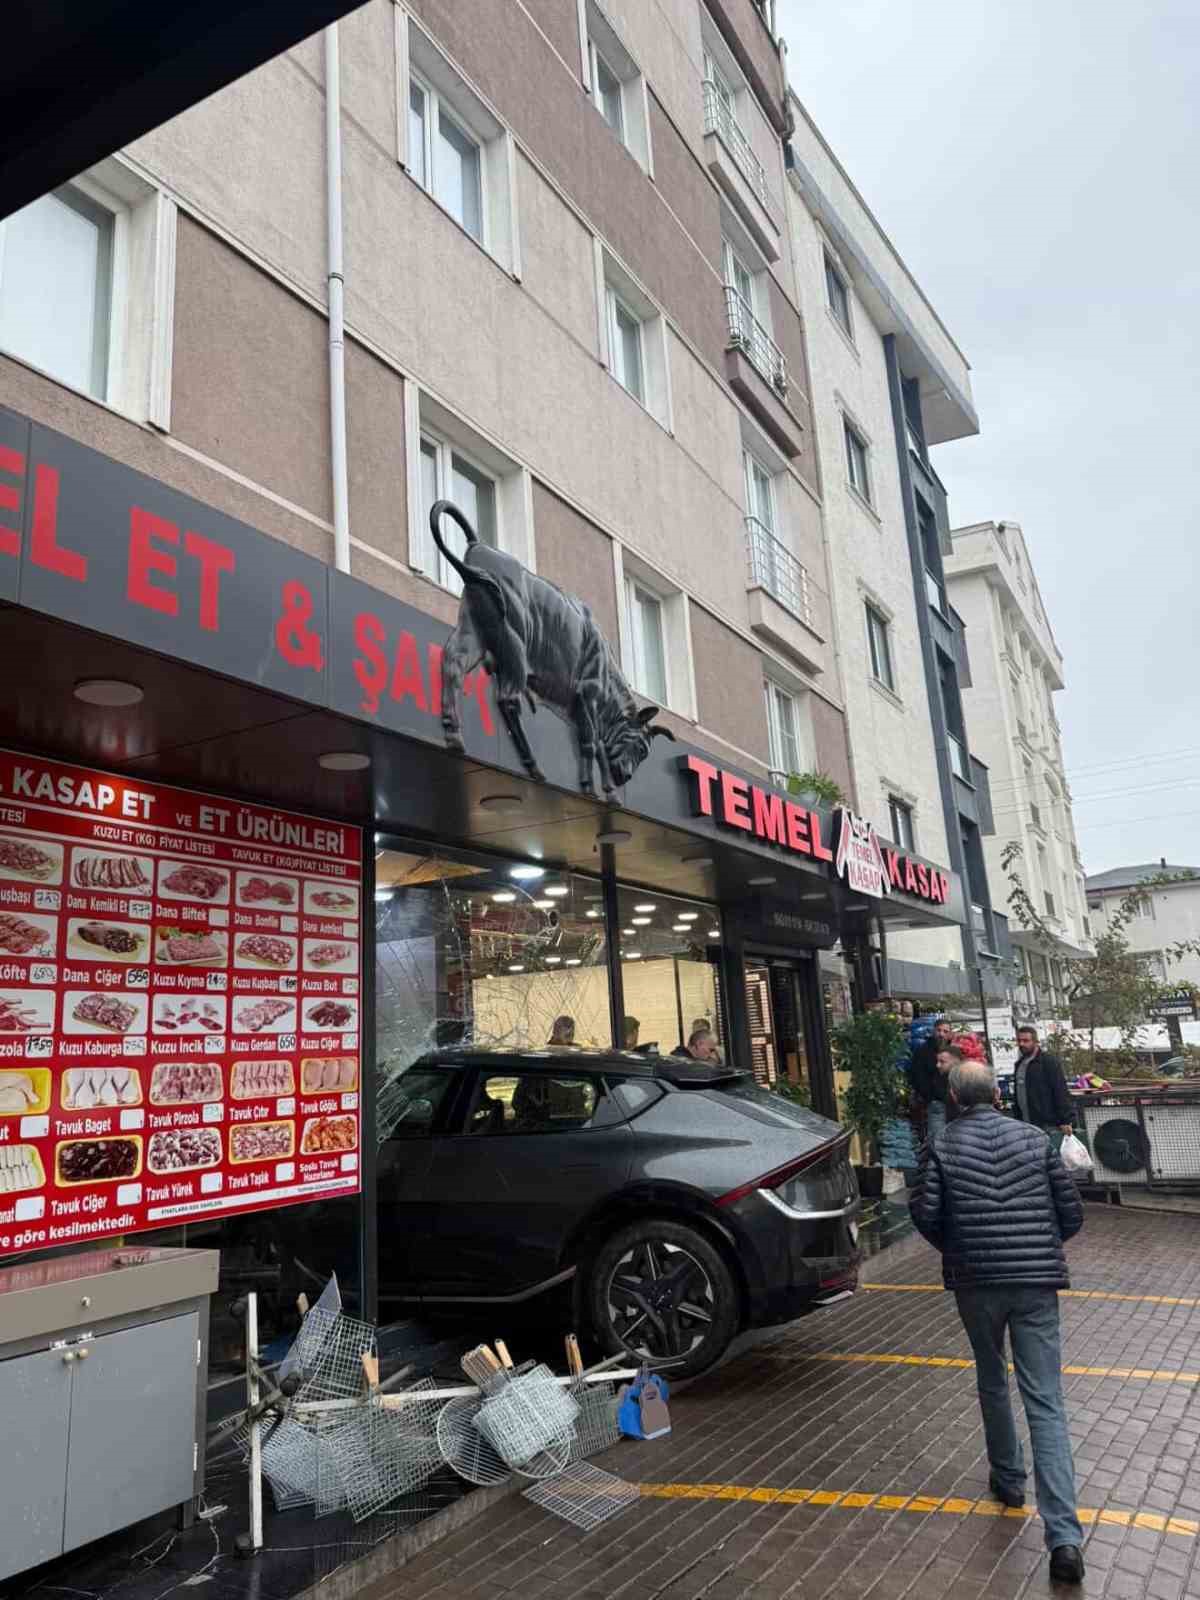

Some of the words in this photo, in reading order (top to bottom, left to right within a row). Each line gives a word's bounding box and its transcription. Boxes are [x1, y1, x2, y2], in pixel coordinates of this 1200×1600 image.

[127, 506, 236, 632] ET
[275, 579, 325, 672] &
[13, 767, 116, 811] KASAP
[122, 789, 156, 819] ET
[176, 813, 192, 827] VE
[200, 805, 230, 833] ET
[237, 807, 345, 854] ÜRÜNLERİ
[687, 753, 833, 862] TEMEL
[886, 849, 950, 904] KASAP
[93, 825, 121, 840] KUZU
[122, 830, 133, 842] ET
[160, 835, 183, 851] FİYAT
[185, 839, 216, 856] LİSTESİ
[232, 848, 261, 863] TAVUK
[263, 854, 273, 865] ET
[67, 894, 87, 910] Dana
[156, 904, 178, 920] Dana
[63, 968, 90, 983] Dana
[95, 968, 122, 986] Ciğer
[153, 972, 176, 987] Kuzu
[178, 973, 205, 990] Kıyma
[302, 979, 322, 991] Kuzu
[59, 1041, 82, 1056] Kuzu
[84, 1041, 122, 1057] Kaburga
[151, 1039, 177, 1054] Kuzu
[179, 1035, 204, 1053] İncik
[148, 1112, 173, 1128] Tavuk
[229, 1106, 252, 1121] Tavuk
[55, 1119, 83, 1136] Tavuk
[85, 1117, 112, 1133] Baget
[228, 1174, 249, 1189] Tavuk
[146, 1184, 170, 1203] Tavuk
[51, 1196, 80, 1216] Tavuk
[82, 1193, 108, 1213] Ciğer
[14, 1229, 46, 1248] göre
[49, 1215, 137, 1240] kesilmektedir.
